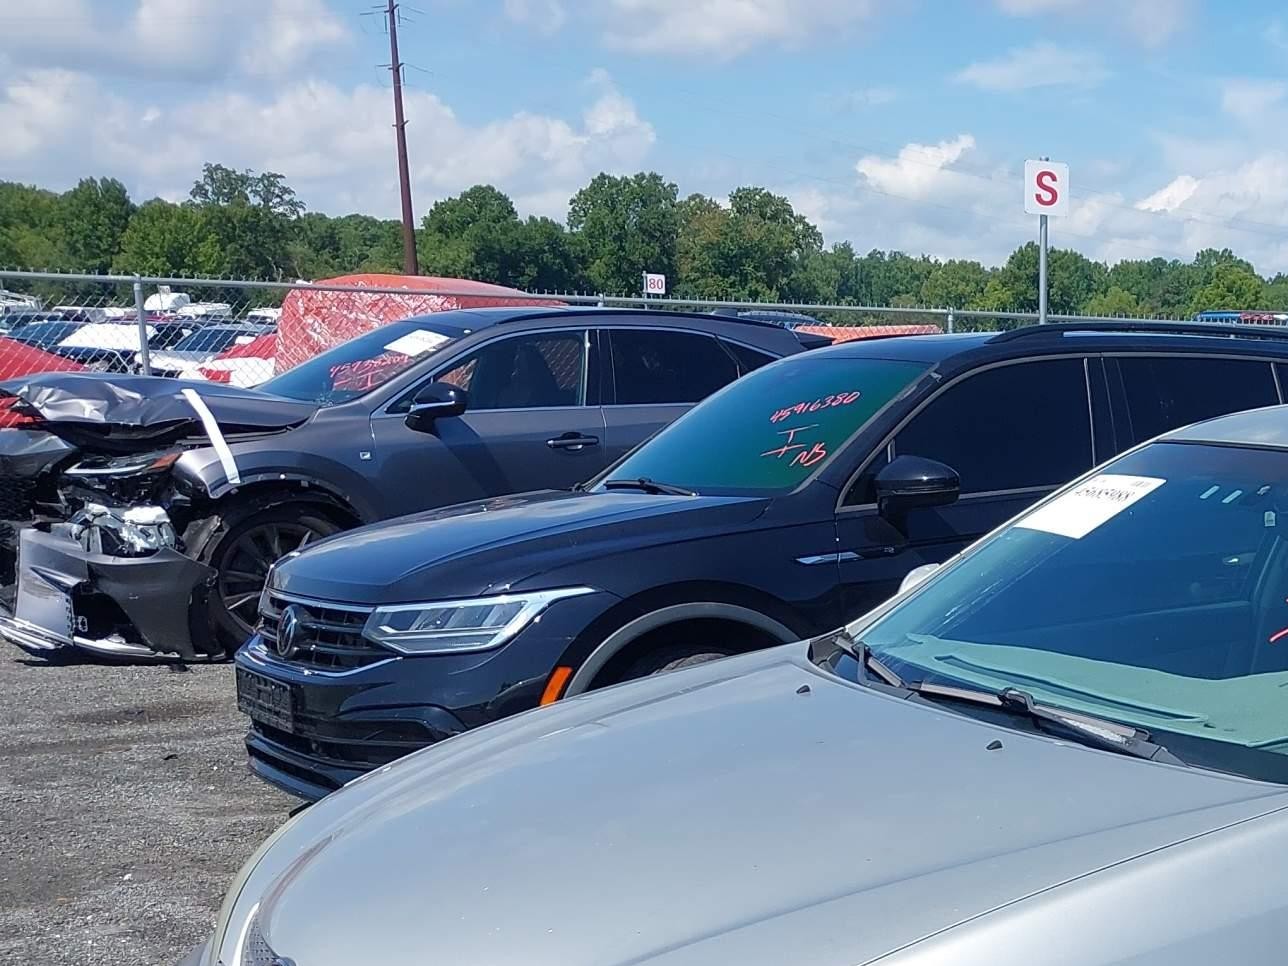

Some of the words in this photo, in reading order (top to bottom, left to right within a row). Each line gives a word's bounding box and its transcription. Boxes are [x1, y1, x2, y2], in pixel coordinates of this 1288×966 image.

[1035, 170, 1058, 206] S
[649, 278, 664, 290] 80
[769, 391, 861, 424] 45916380
